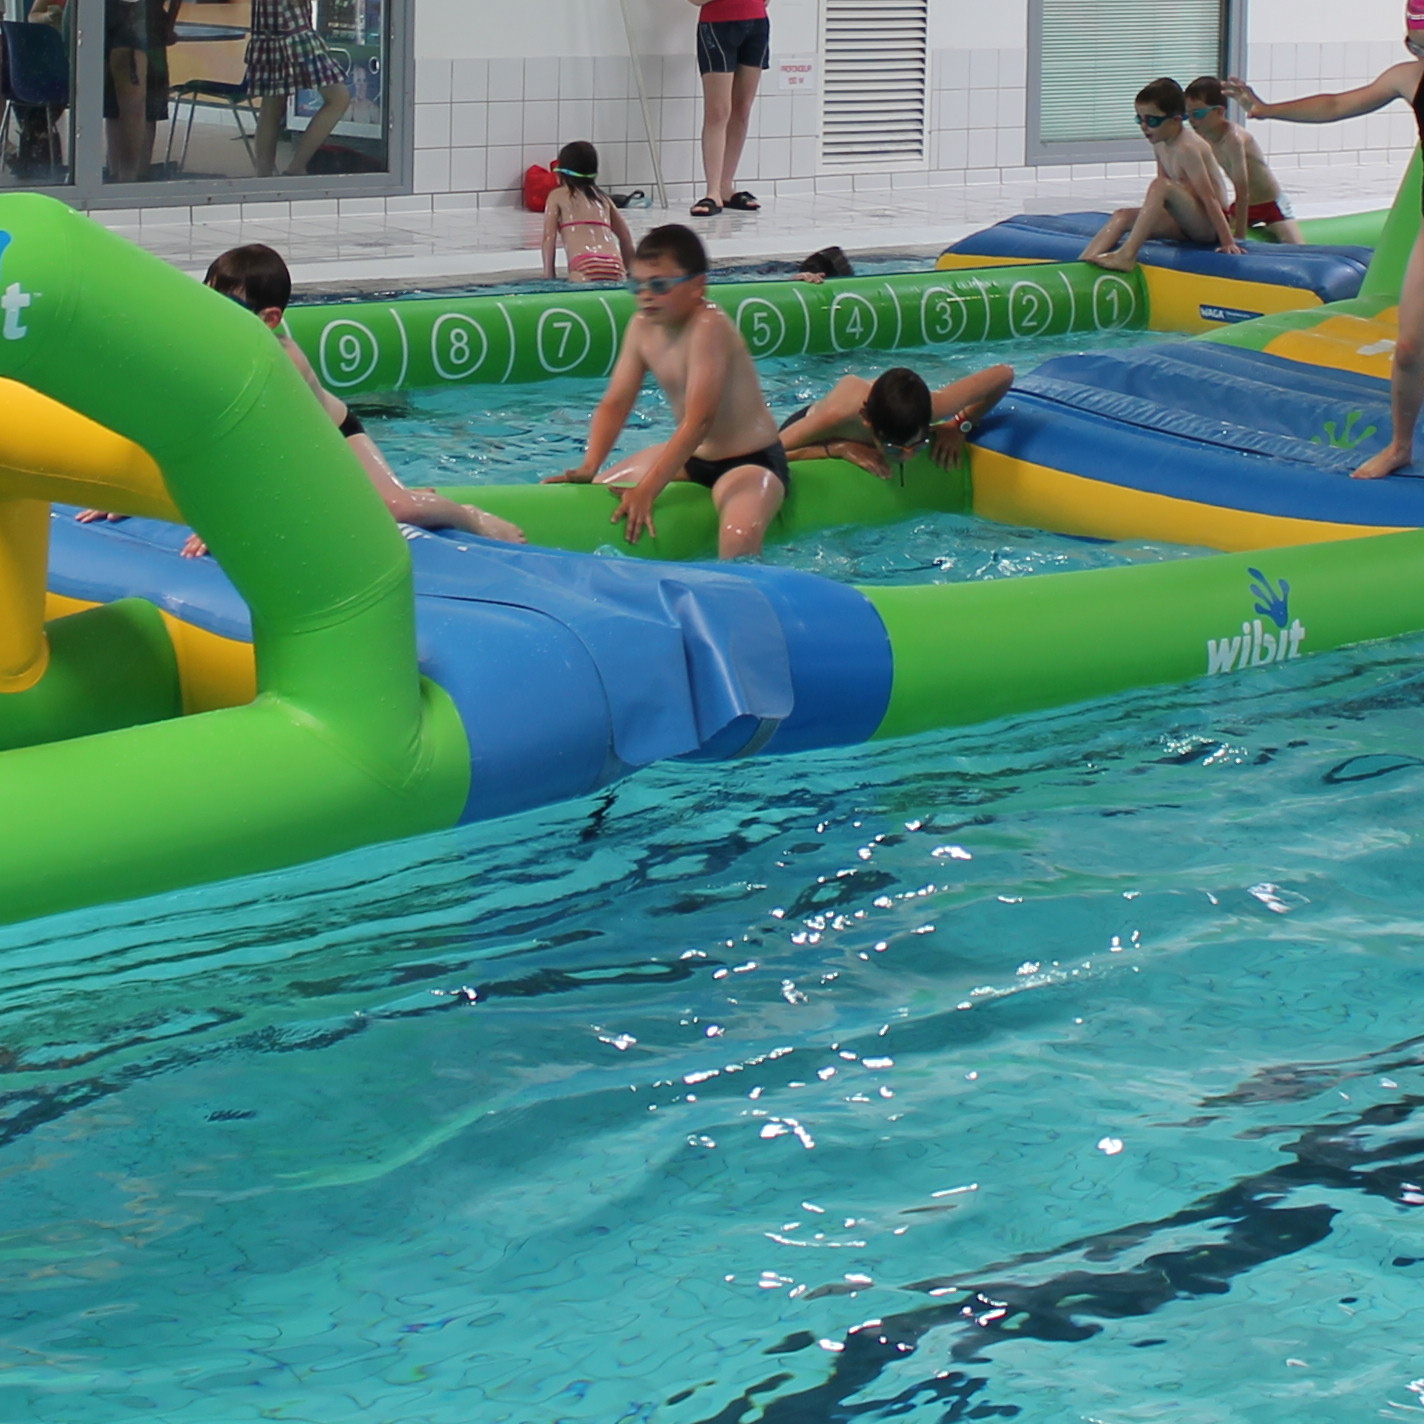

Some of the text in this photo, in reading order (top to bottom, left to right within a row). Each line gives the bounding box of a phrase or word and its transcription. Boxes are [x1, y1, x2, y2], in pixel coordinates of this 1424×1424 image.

[339, 289, 1118, 372] 9 8 7 5 4 3 2 1
[1207, 618, 1306, 676] wibit
